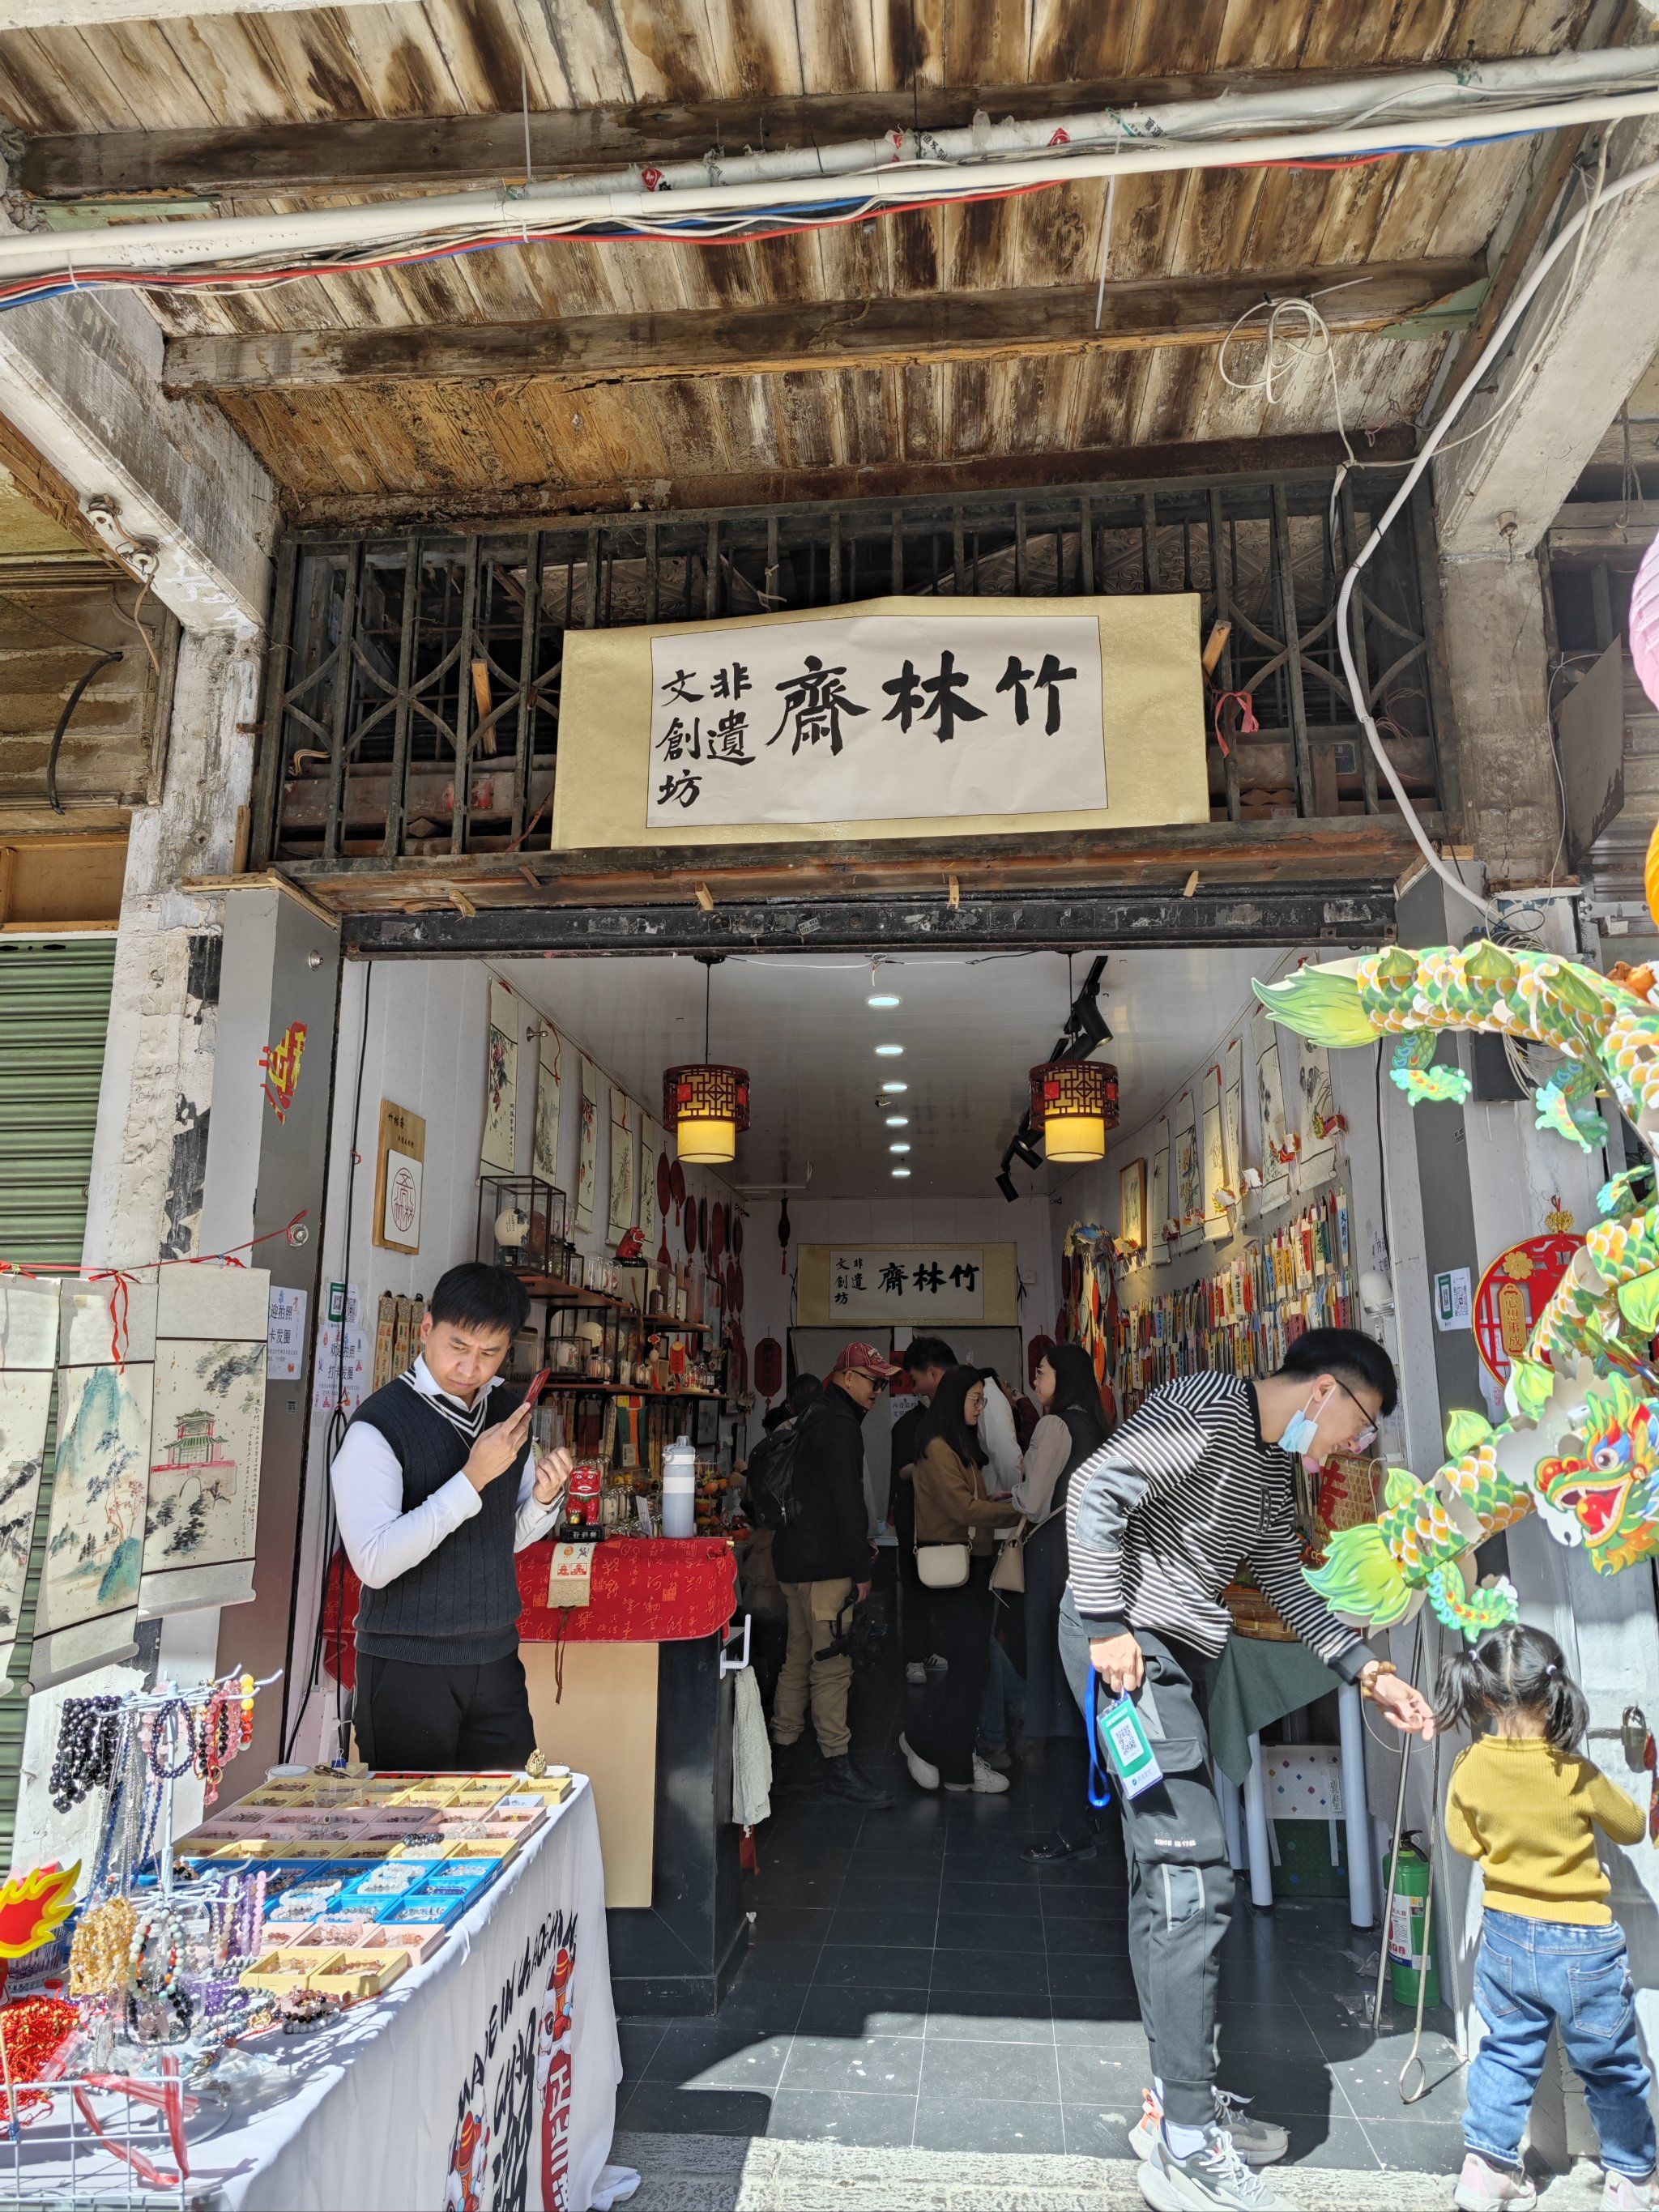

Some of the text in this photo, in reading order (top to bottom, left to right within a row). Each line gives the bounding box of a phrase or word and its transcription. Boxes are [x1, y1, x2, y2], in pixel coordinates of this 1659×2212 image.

[655, 668, 705, 808] 文創坊
[707, 661, 757, 766] 非遺
[834, 1257, 851, 1306] 文創坊
[268, 1303, 293, 1321] 迎拍照
[1505, 1297, 1522, 1347] 心想事成
